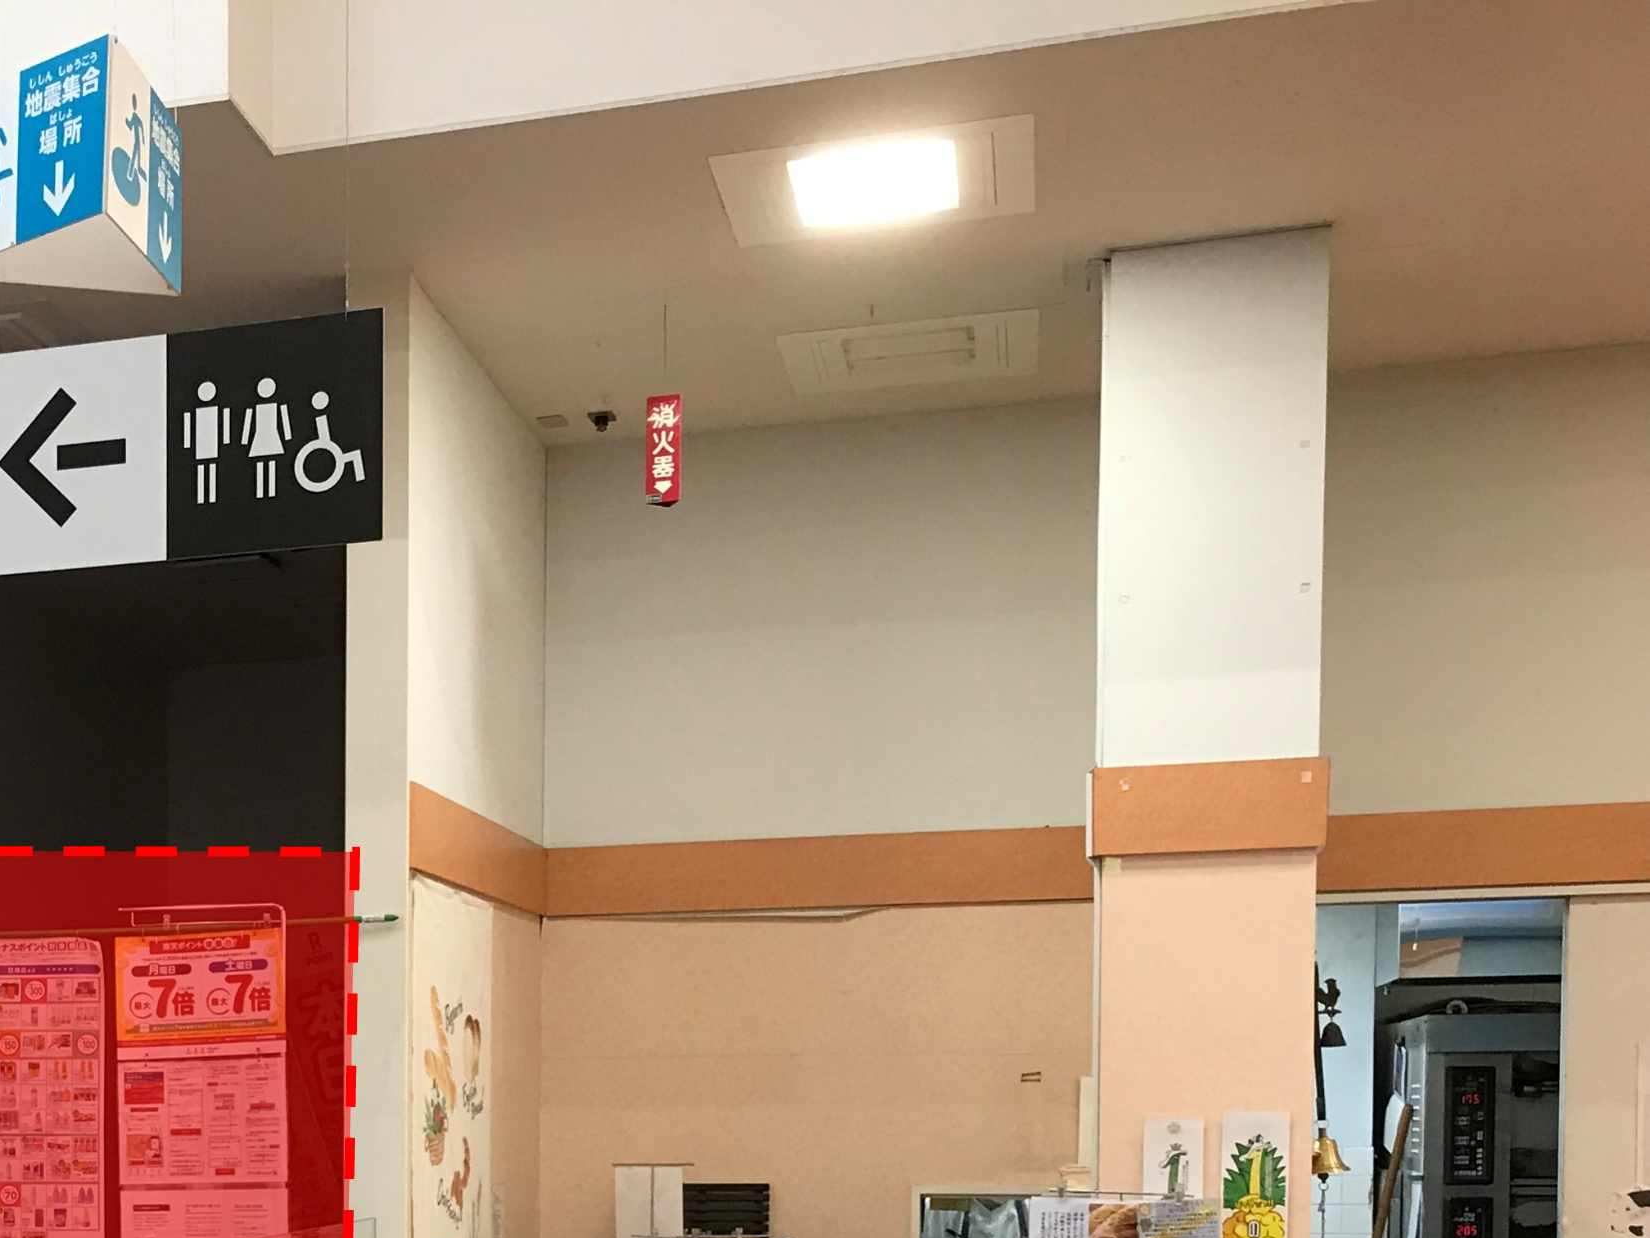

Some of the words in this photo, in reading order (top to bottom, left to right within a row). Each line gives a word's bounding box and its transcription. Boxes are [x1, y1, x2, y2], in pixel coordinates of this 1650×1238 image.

[29, 72, 53, 88] じしん
[58, 52, 97, 76] しゅうごう
[25, 68, 101, 117] 地震集合
[39, 116, 82, 155] 場所
[49, 110, 72, 125] ばしょ
[647, 400, 680, 478] 消火器
[149, 963, 176, 976] 月曜日
[225, 958, 252, 971] 土曜日
[148, 978, 195, 1018] 7倍
[225, 974, 272, 1014] 7倍
